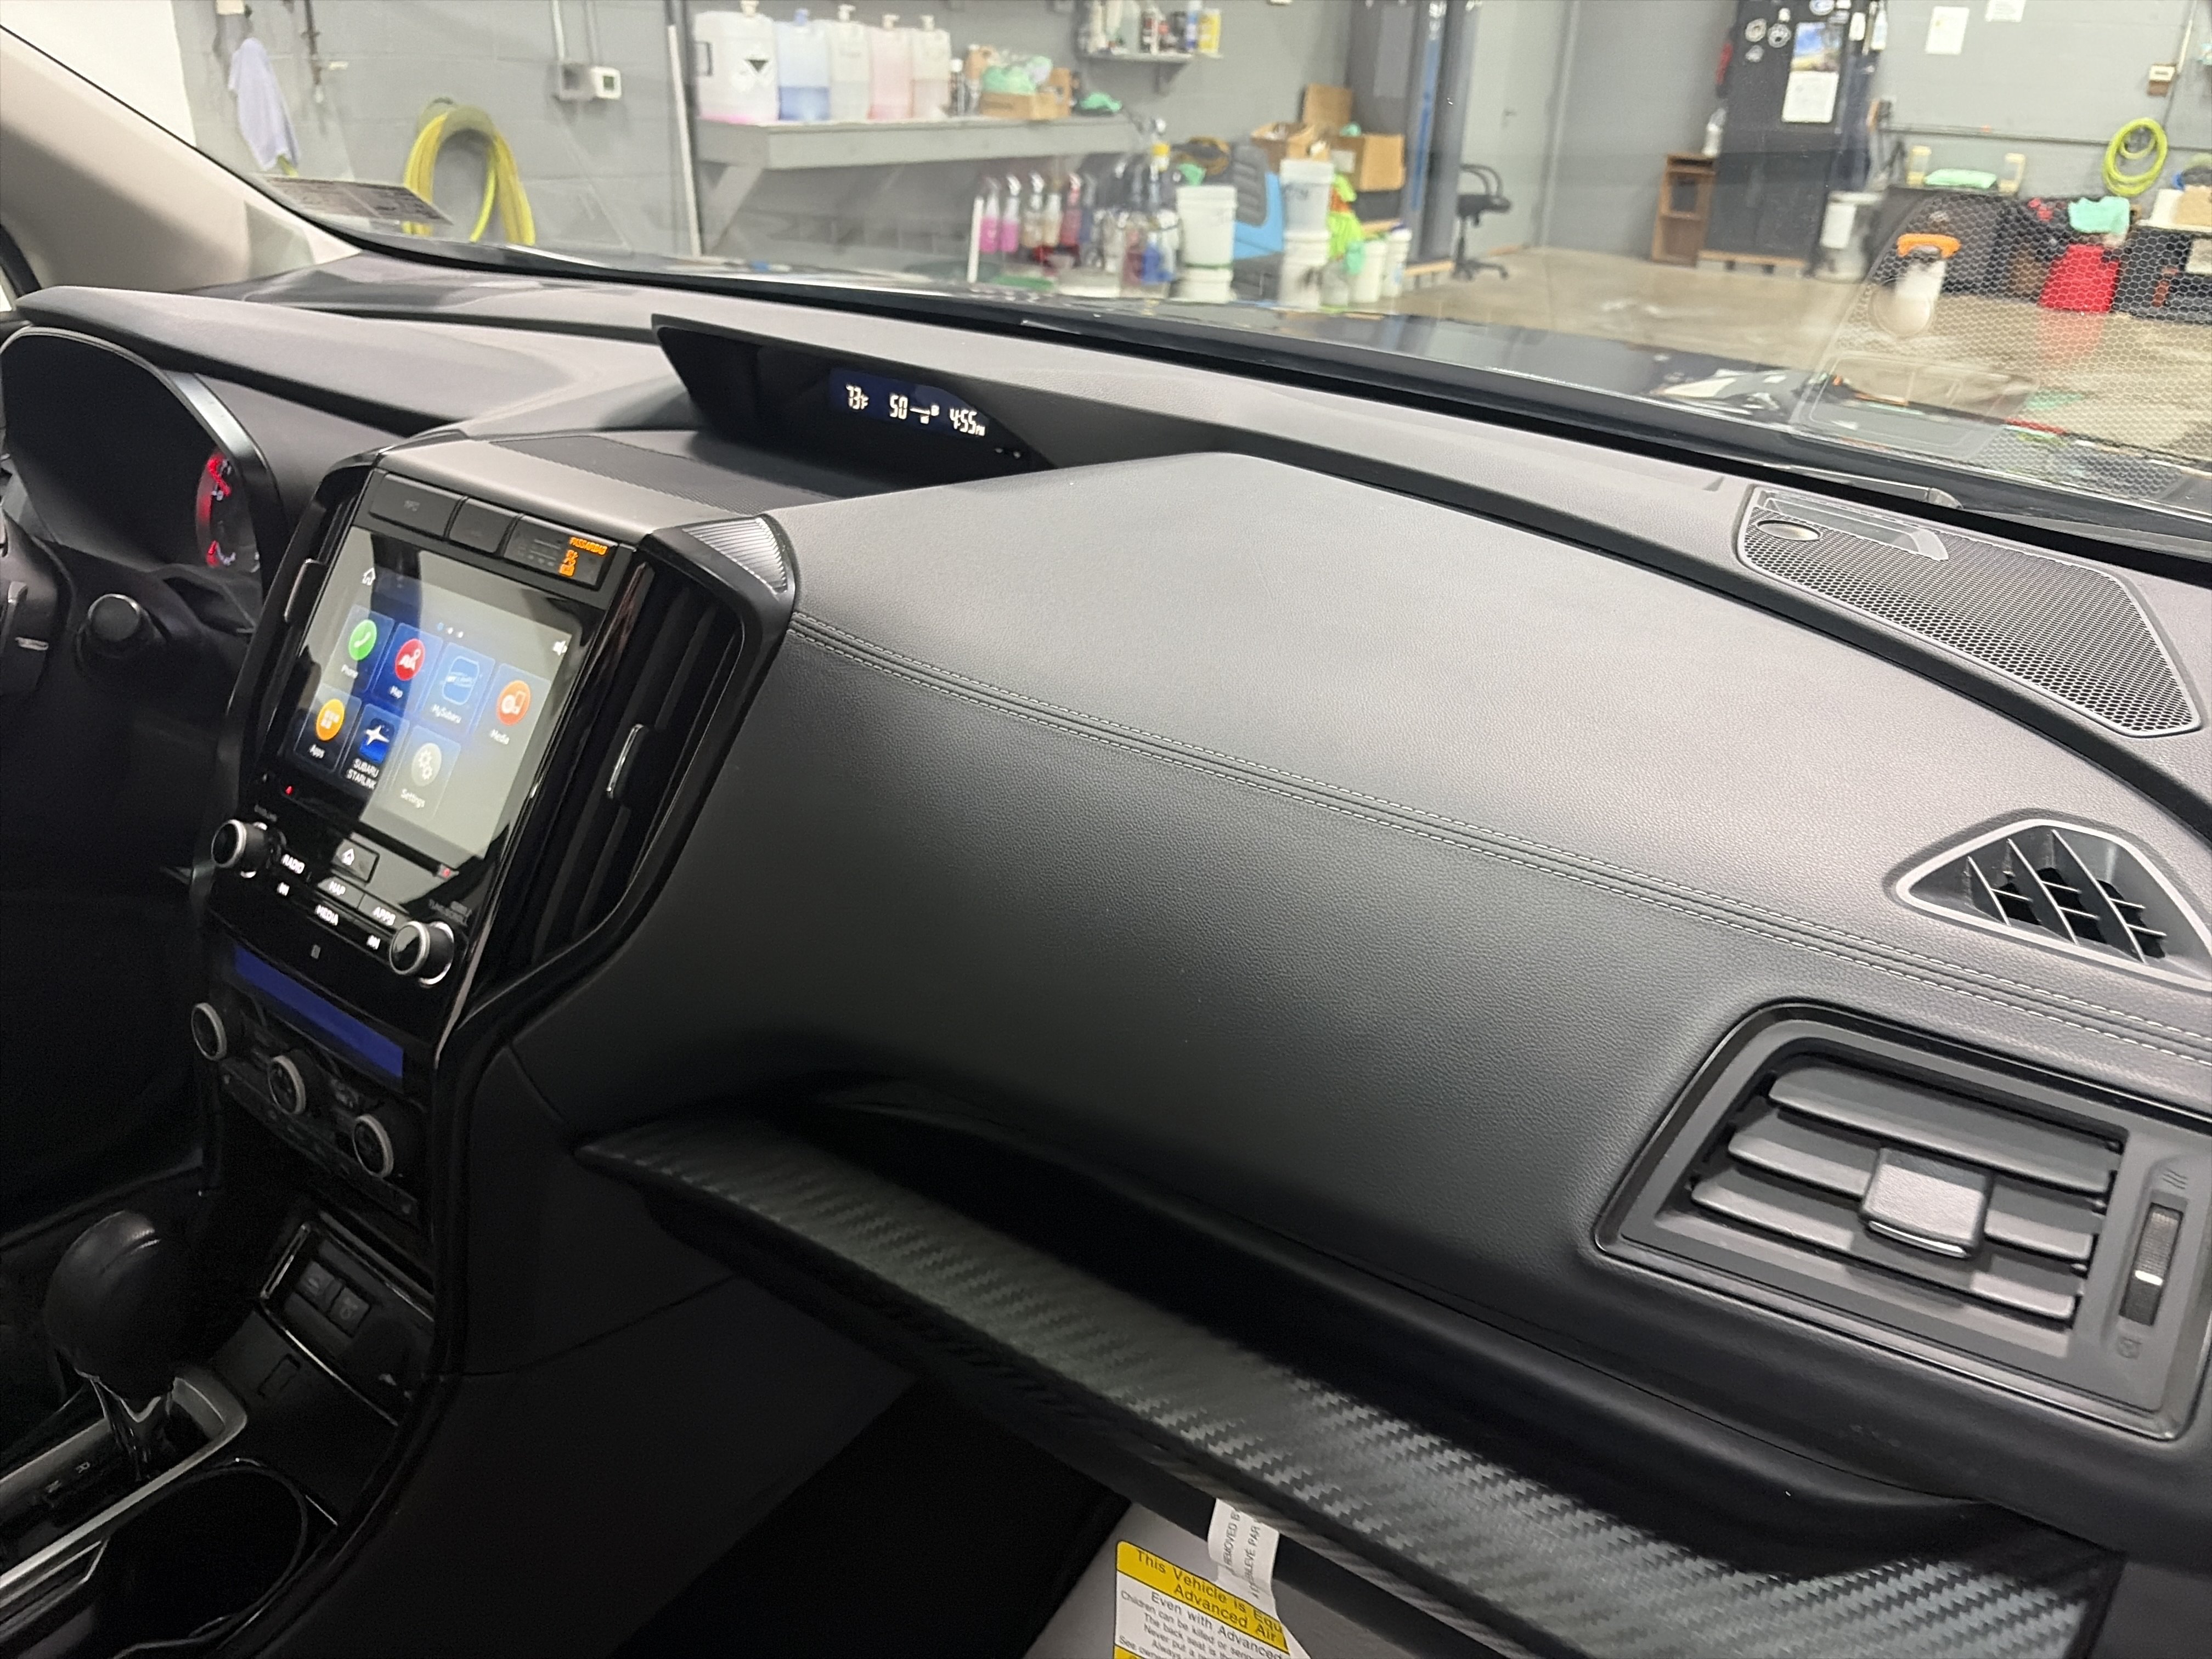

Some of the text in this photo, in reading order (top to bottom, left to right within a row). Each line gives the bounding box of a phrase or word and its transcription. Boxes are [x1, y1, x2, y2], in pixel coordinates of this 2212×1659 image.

[890, 392, 908, 419] 50
[390, 685, 403, 699] Map
[431, 704, 462, 724] MySubaru
[490, 729, 510, 745] Media
[309, 743, 325, 759] Apps
[353, 758, 380, 778] SUBARU
[346, 769, 377, 789] STARLINK
[400, 788, 425, 808] Settings
[281, 854, 305, 874] RADIO
[329, 881, 346, 895] MAP
[315, 905, 338, 926] MEDIA
[373, 906, 396, 926] APPS
[1248, 1525, 1261, 1547] PAR
[1137, 1549, 1166, 1575] This
[1173, 1566, 1227, 1603] Vehicle
[1234, 1598, 1246, 1613] is
[1121, 1590, 1156, 1614] Children
[1158, 1611, 1174, 1624] can
[1177, 1618, 1189, 1631] be
[1192, 1626, 1215, 1644] killed
[1152, 1592, 1182, 1615] Even
[1187, 1610, 1213, 1630] with
[1173, 1584, 1248, 1629] Advanced
[1256, 1623, 1276, 1642] Air
[1144, 1612, 1160, 1628] The
[1163, 1623, 1183, 1640] back
[1144, 1623, 1169, 1642] Never
[1119, 1635, 1136, 1650] See
